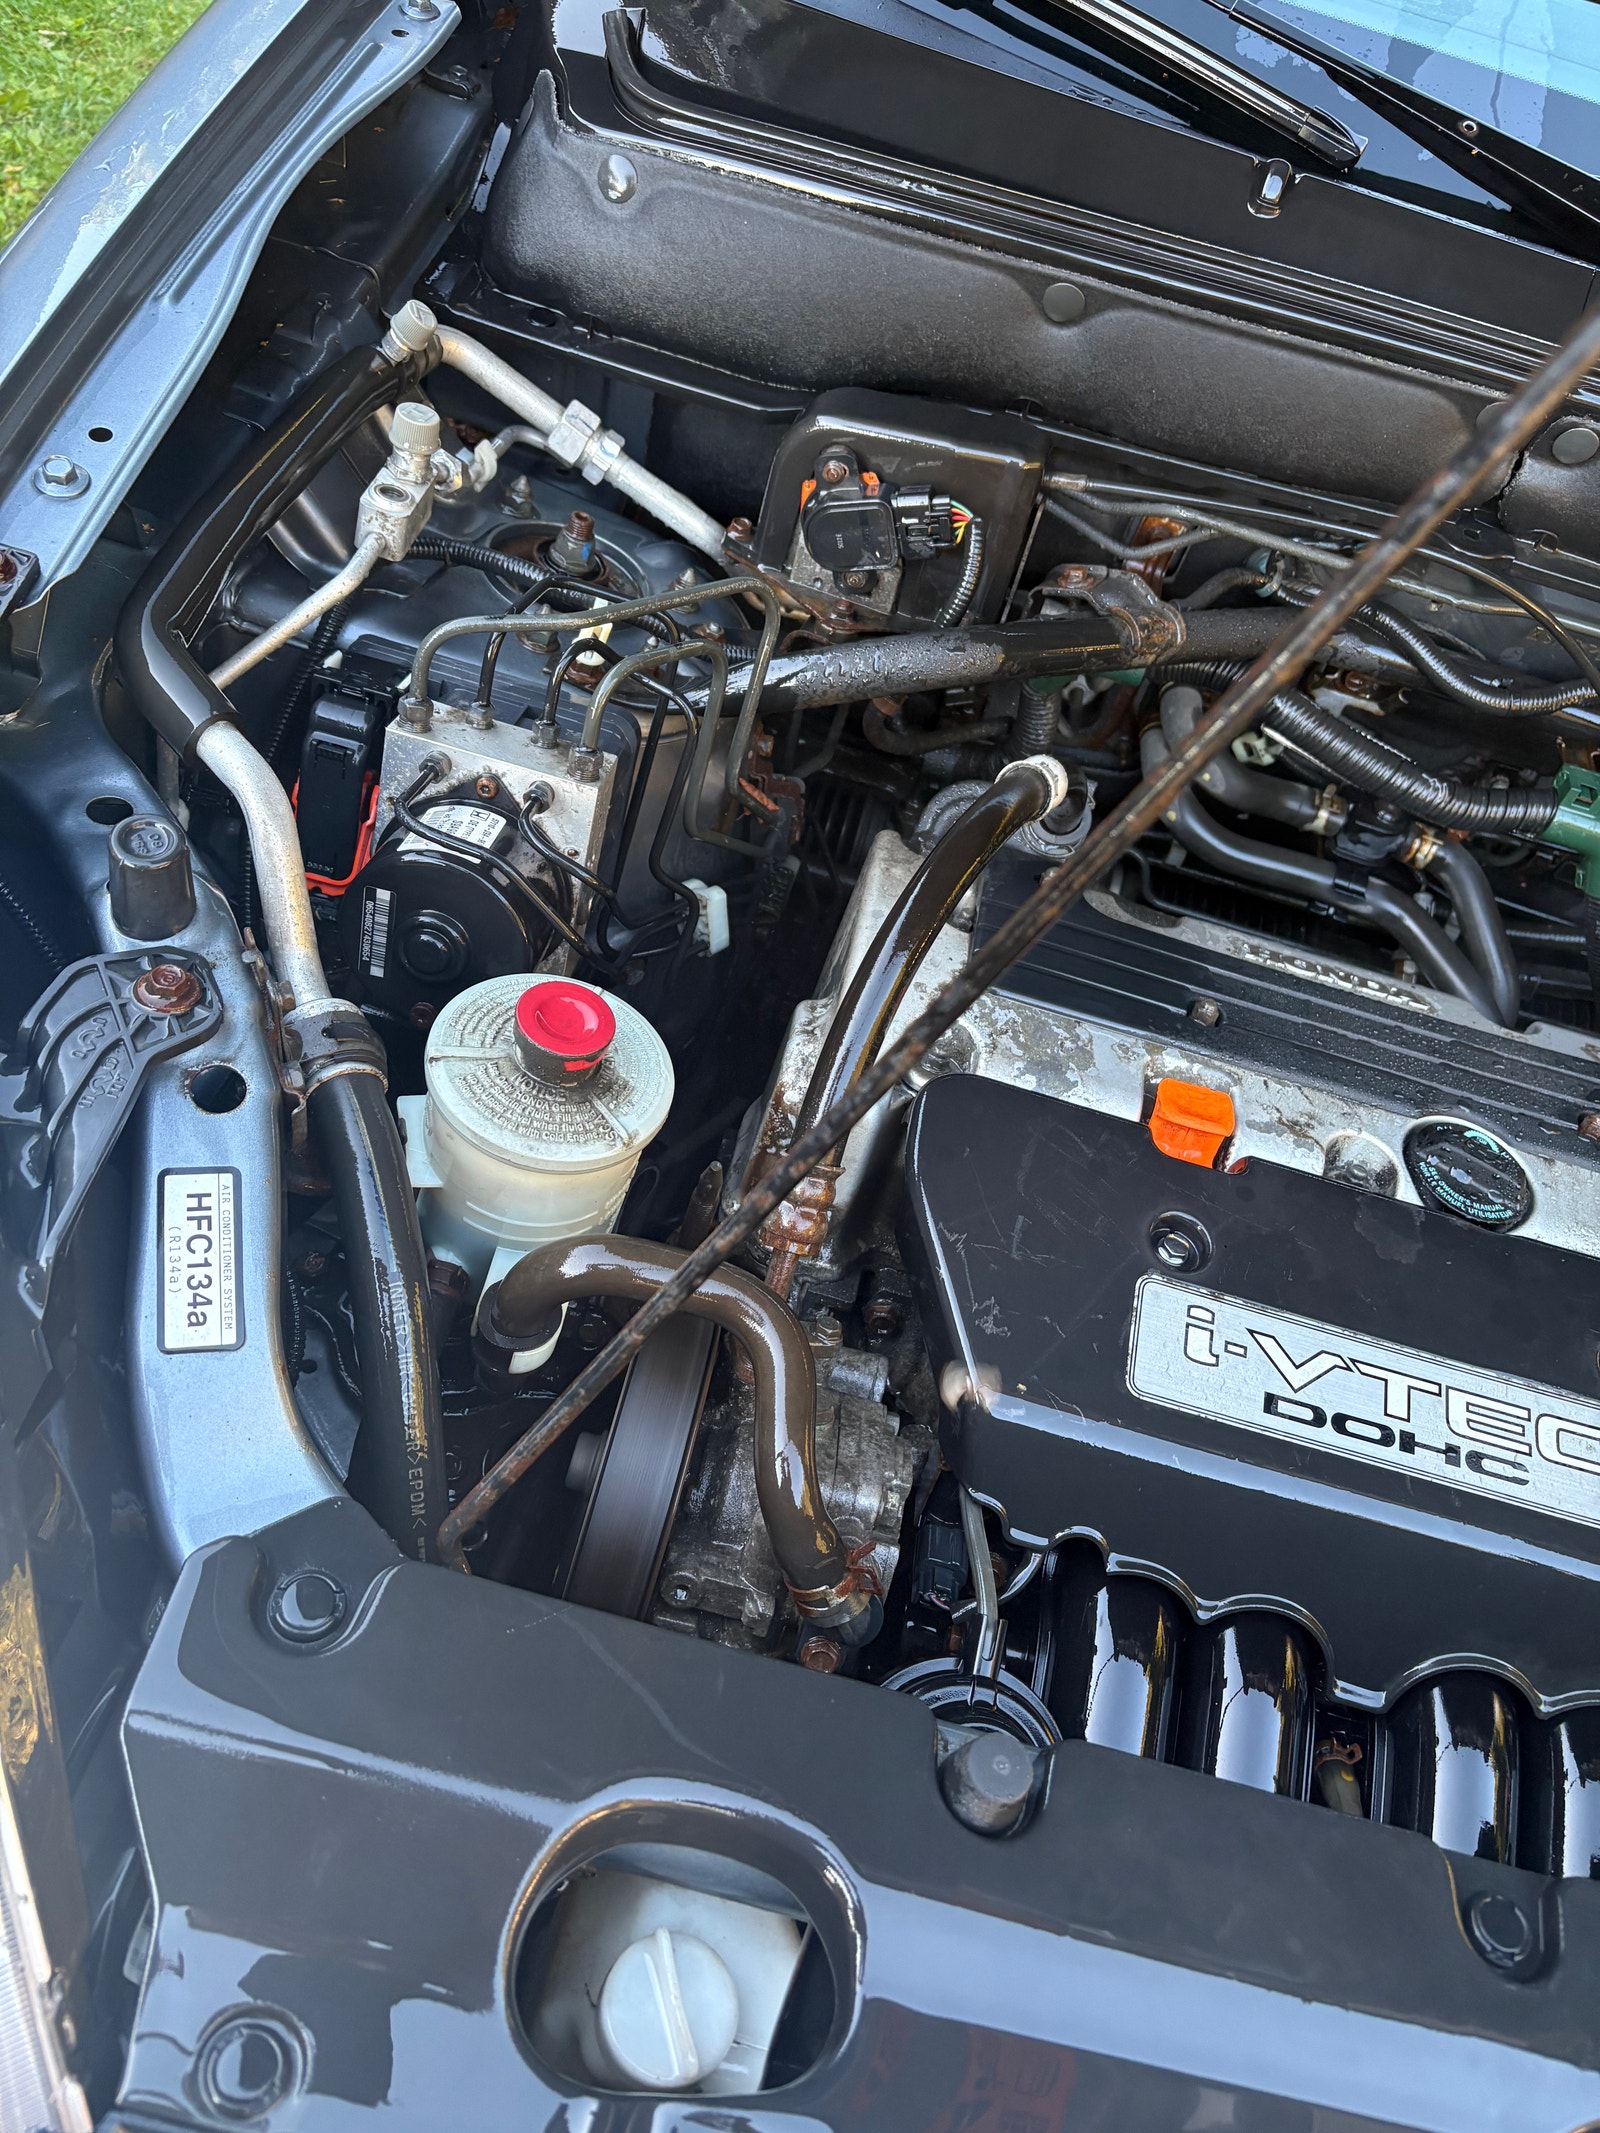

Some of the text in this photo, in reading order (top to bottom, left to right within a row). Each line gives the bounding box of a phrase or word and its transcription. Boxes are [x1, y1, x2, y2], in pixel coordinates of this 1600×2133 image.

[493, 1086, 527, 1112] Steering
[498, 1076, 516, 1095] Only
[515, 1090, 551, 1111] HONDA
[551, 1100, 592, 1113] Genuine
[511, 1073, 567, 1102] NOTICE
[472, 1098, 498, 1119] Lower
[495, 1115, 520, 1133] Level
[520, 1126, 541, 1139] with
[543, 1131, 565, 1142] Cold
[483, 1092, 509, 1115] Upper
[507, 1110, 531, 1125] Level
[533, 1119, 560, 1131] when
[1428, 1166, 1505, 1212] SEE OWNER'S MANUAL
[1467, 1208, 1515, 1219] UTILISATEUR
[168, 1226, 181, 1293] (R134a)
[186, 1193, 213, 1328] HFC134a
[221, 1184, 233, 1330] AIR CONDITIONER SYSTEM
[1184, 1305, 1600, 1476] i-VTEC
[1263, 1391, 1530, 1486] DOHC
